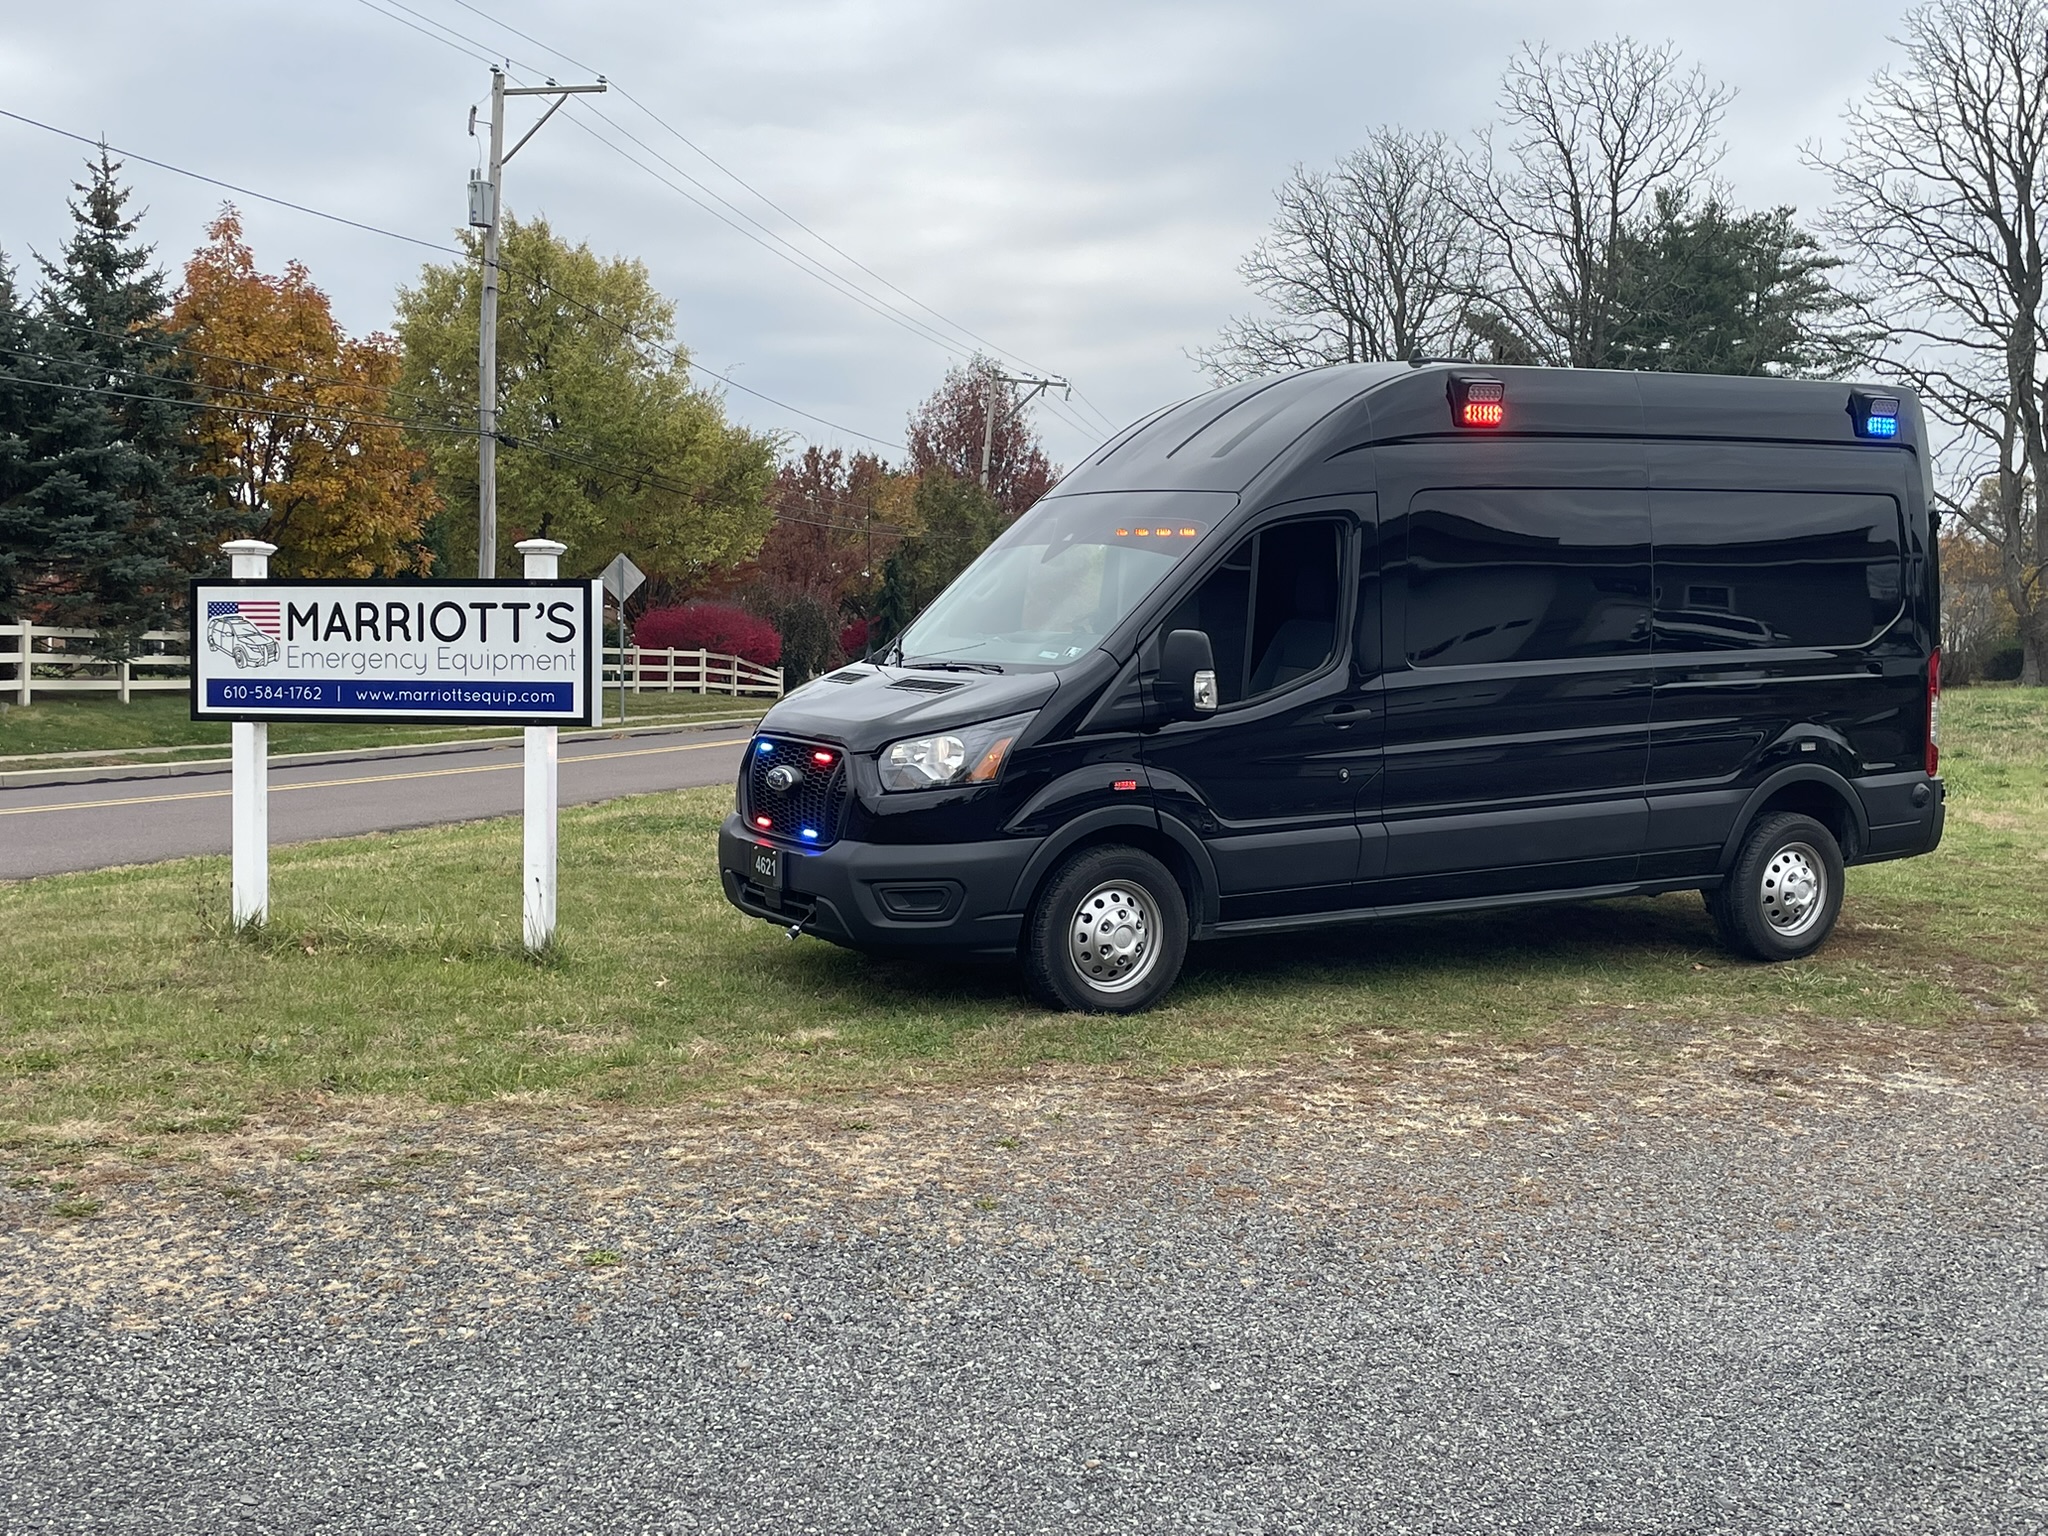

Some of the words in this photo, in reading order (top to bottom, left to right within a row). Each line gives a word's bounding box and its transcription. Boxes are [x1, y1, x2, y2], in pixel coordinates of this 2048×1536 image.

[287, 601, 576, 643] MARRIOTT'S
[287, 645, 427, 675] Emergency
[438, 647, 576, 676] Equipment
[223, 685, 322, 700] 610-584-1762
[355, 688, 556, 706] www.marriottsequip.com
[755, 855, 776, 877] 4621
